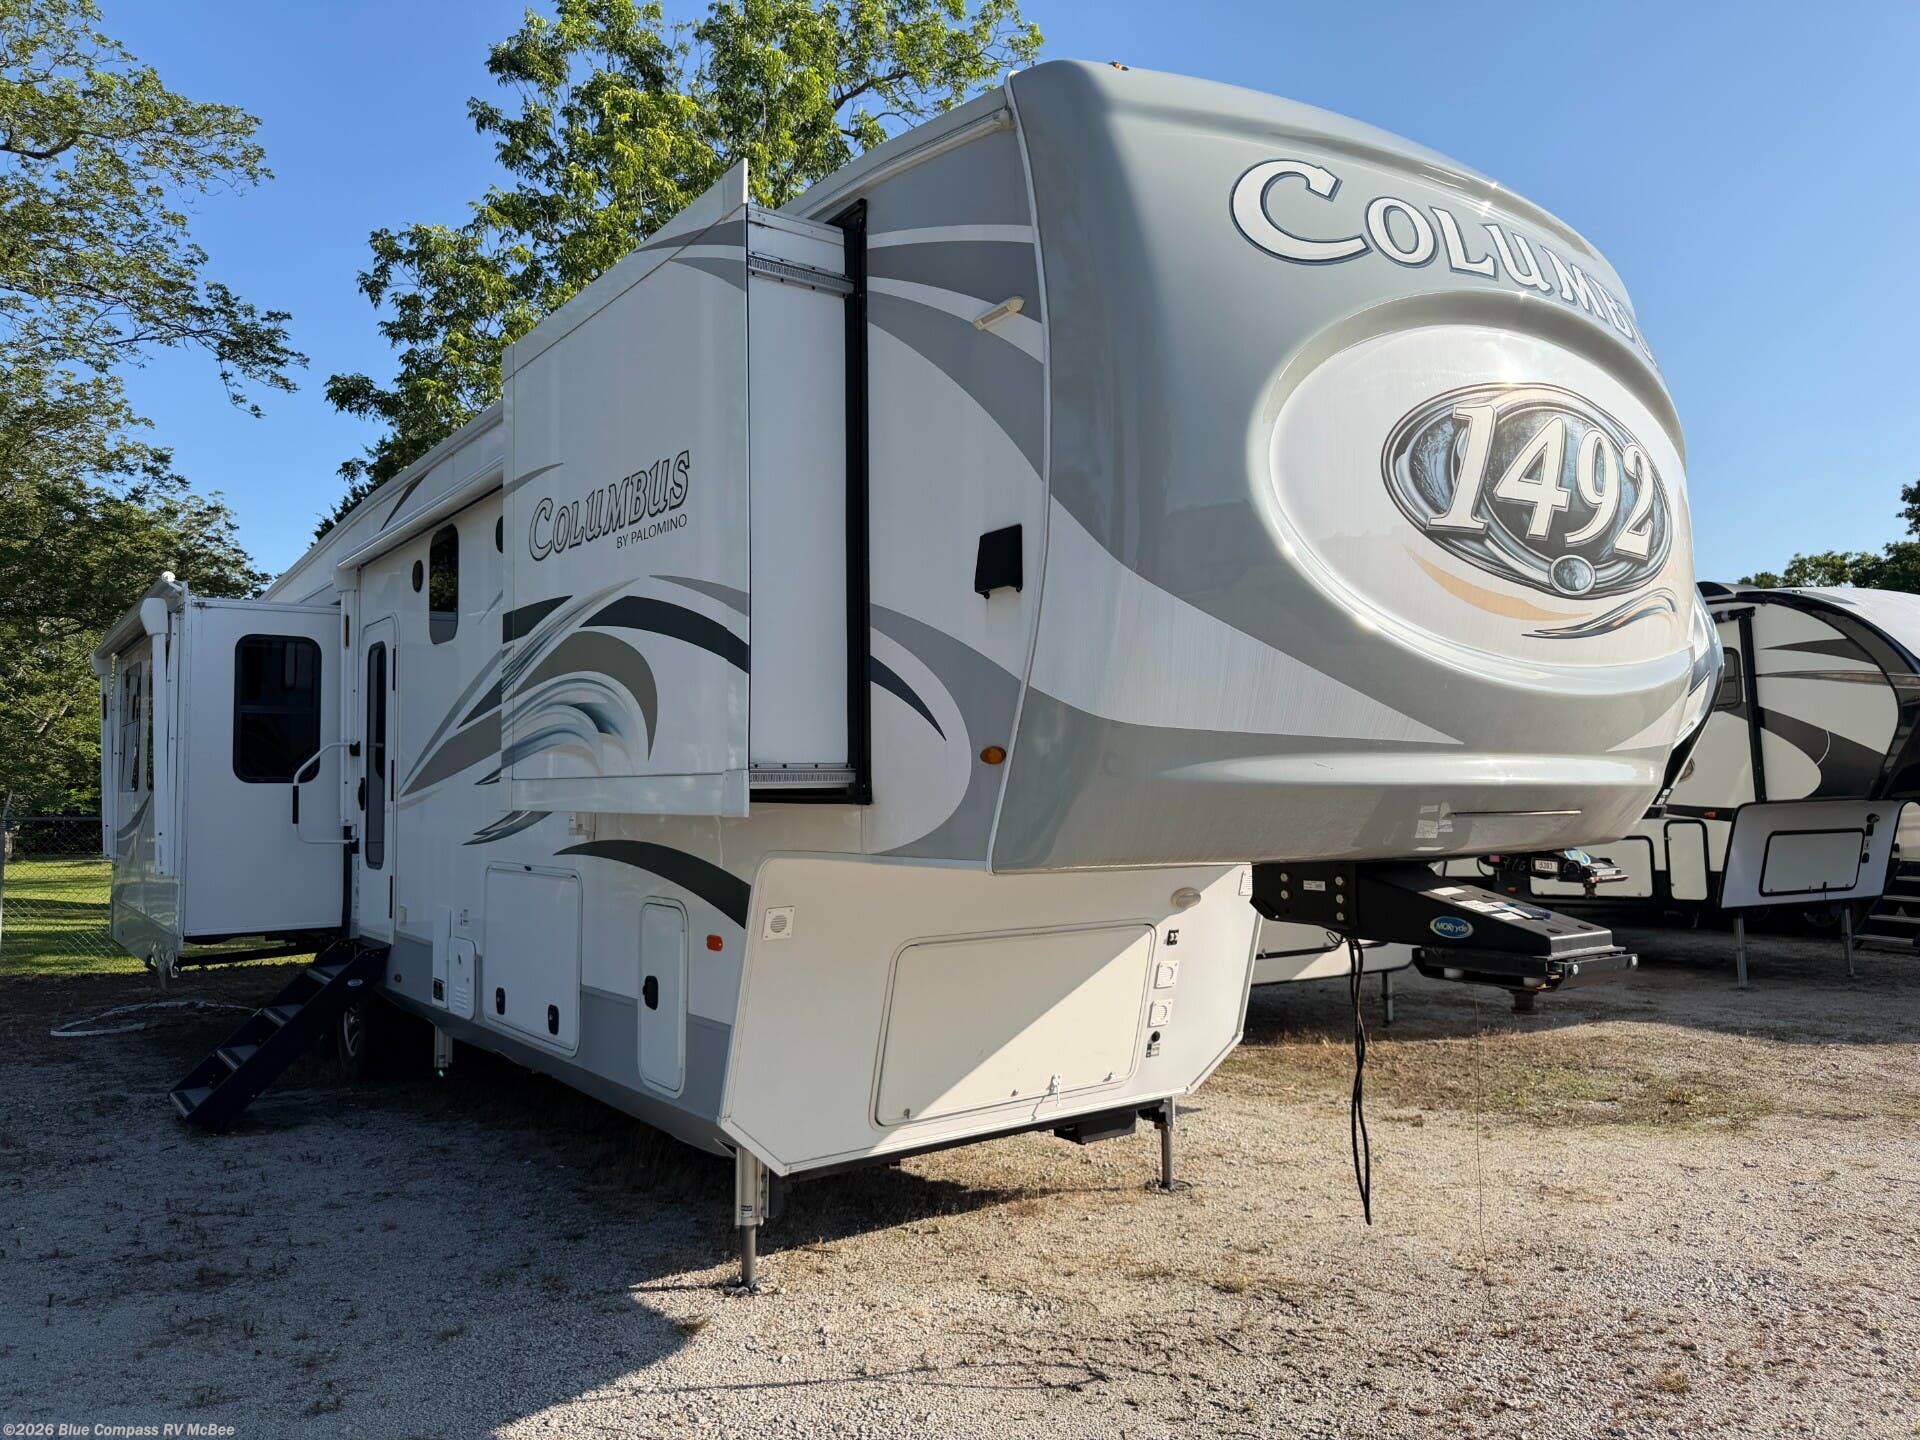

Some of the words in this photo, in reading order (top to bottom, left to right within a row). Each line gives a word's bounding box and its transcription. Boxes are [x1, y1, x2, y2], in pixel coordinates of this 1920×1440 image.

[528, 449, 691, 562] COLUMBUS
[616, 534, 629, 549] BY
[631, 513, 688, 545] PALOMINO
[1426, 404, 1655, 563] 1492
